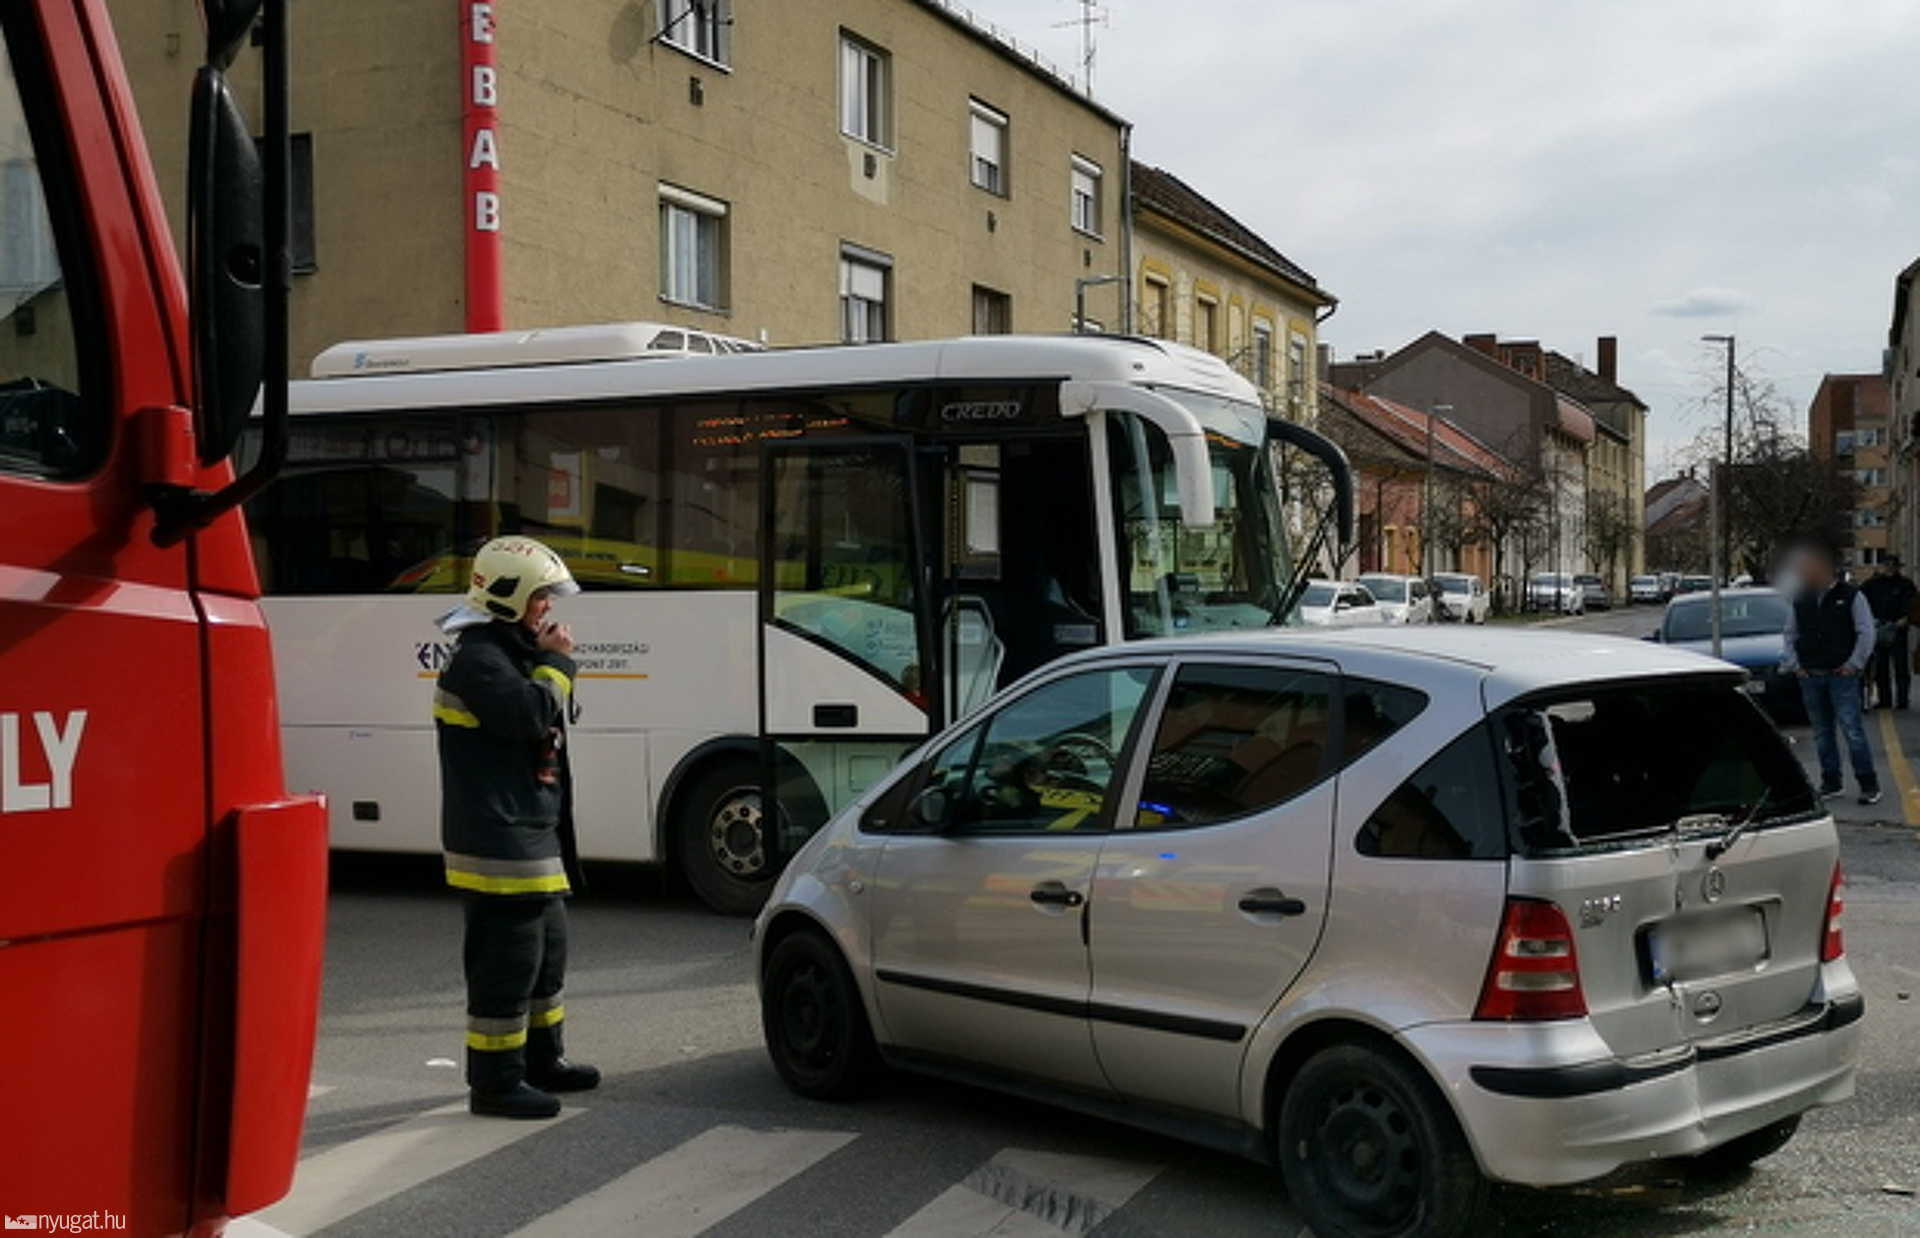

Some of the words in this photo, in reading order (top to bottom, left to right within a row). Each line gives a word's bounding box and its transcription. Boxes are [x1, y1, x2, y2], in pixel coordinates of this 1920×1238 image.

[470, 3, 500, 230] EBAB
[941, 402, 1022, 421] CREDO
[1, 710, 88, 813] LY
